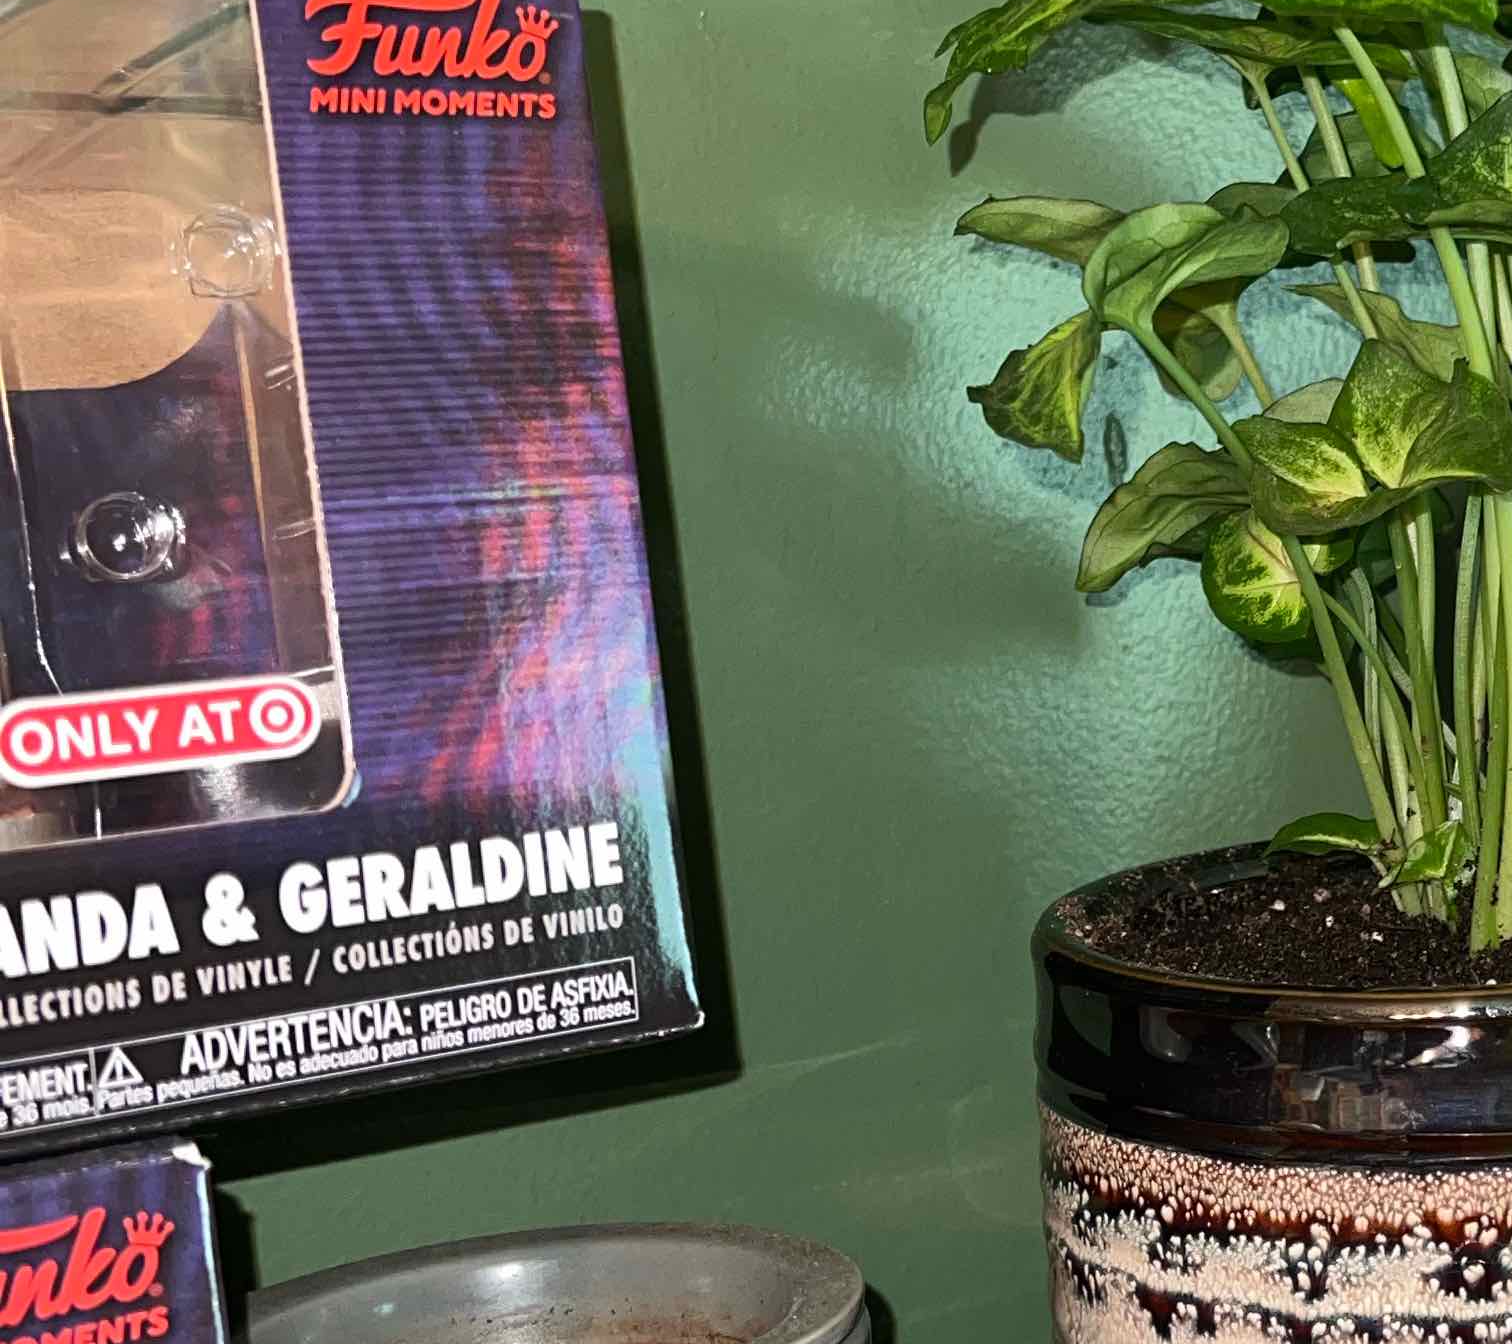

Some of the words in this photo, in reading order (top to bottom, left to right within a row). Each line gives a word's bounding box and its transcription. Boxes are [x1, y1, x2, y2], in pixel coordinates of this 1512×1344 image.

[309, 86, 387, 114] MINI
[394, 88, 556, 119] MOMENTS
[10, 707, 159, 765] ONLY
[178, 700, 242, 748] AT
[202, 872, 260, 946] &
[278, 822, 624, 933] GERALDINE
[152, 971, 188, 1004] DE
[196, 955, 293, 996] VINYLE
[503, 916, 535, 946] DE
[543, 904, 624, 939] VINILO
[97, 1085, 154, 1111] Partes
[247, 1062, 273, 1083] No
[275, 1060, 297, 1078] es
[300, 1044, 379, 1074] adecuado
[381, 1038, 418, 1062] para
[421, 1030, 464, 1052] niños
[467, 1017, 534, 1044] menores
[536, 1012, 556, 1031] de
[559, 1008, 580, 1028] 36
[582, 1000, 636, 1024] meses.
[181, 1001, 413, 1074] ADVERTENCIA:
[420, 991, 512, 1032] PELIGRO
[517, 984, 548, 1015] DE
[551, 971, 635, 1009] ASFIXIA.
[0, 1063, 94, 1104] EMENT.
[11, 1103, 39, 1127] 36
[0, 1207, 160, 1327] nko
